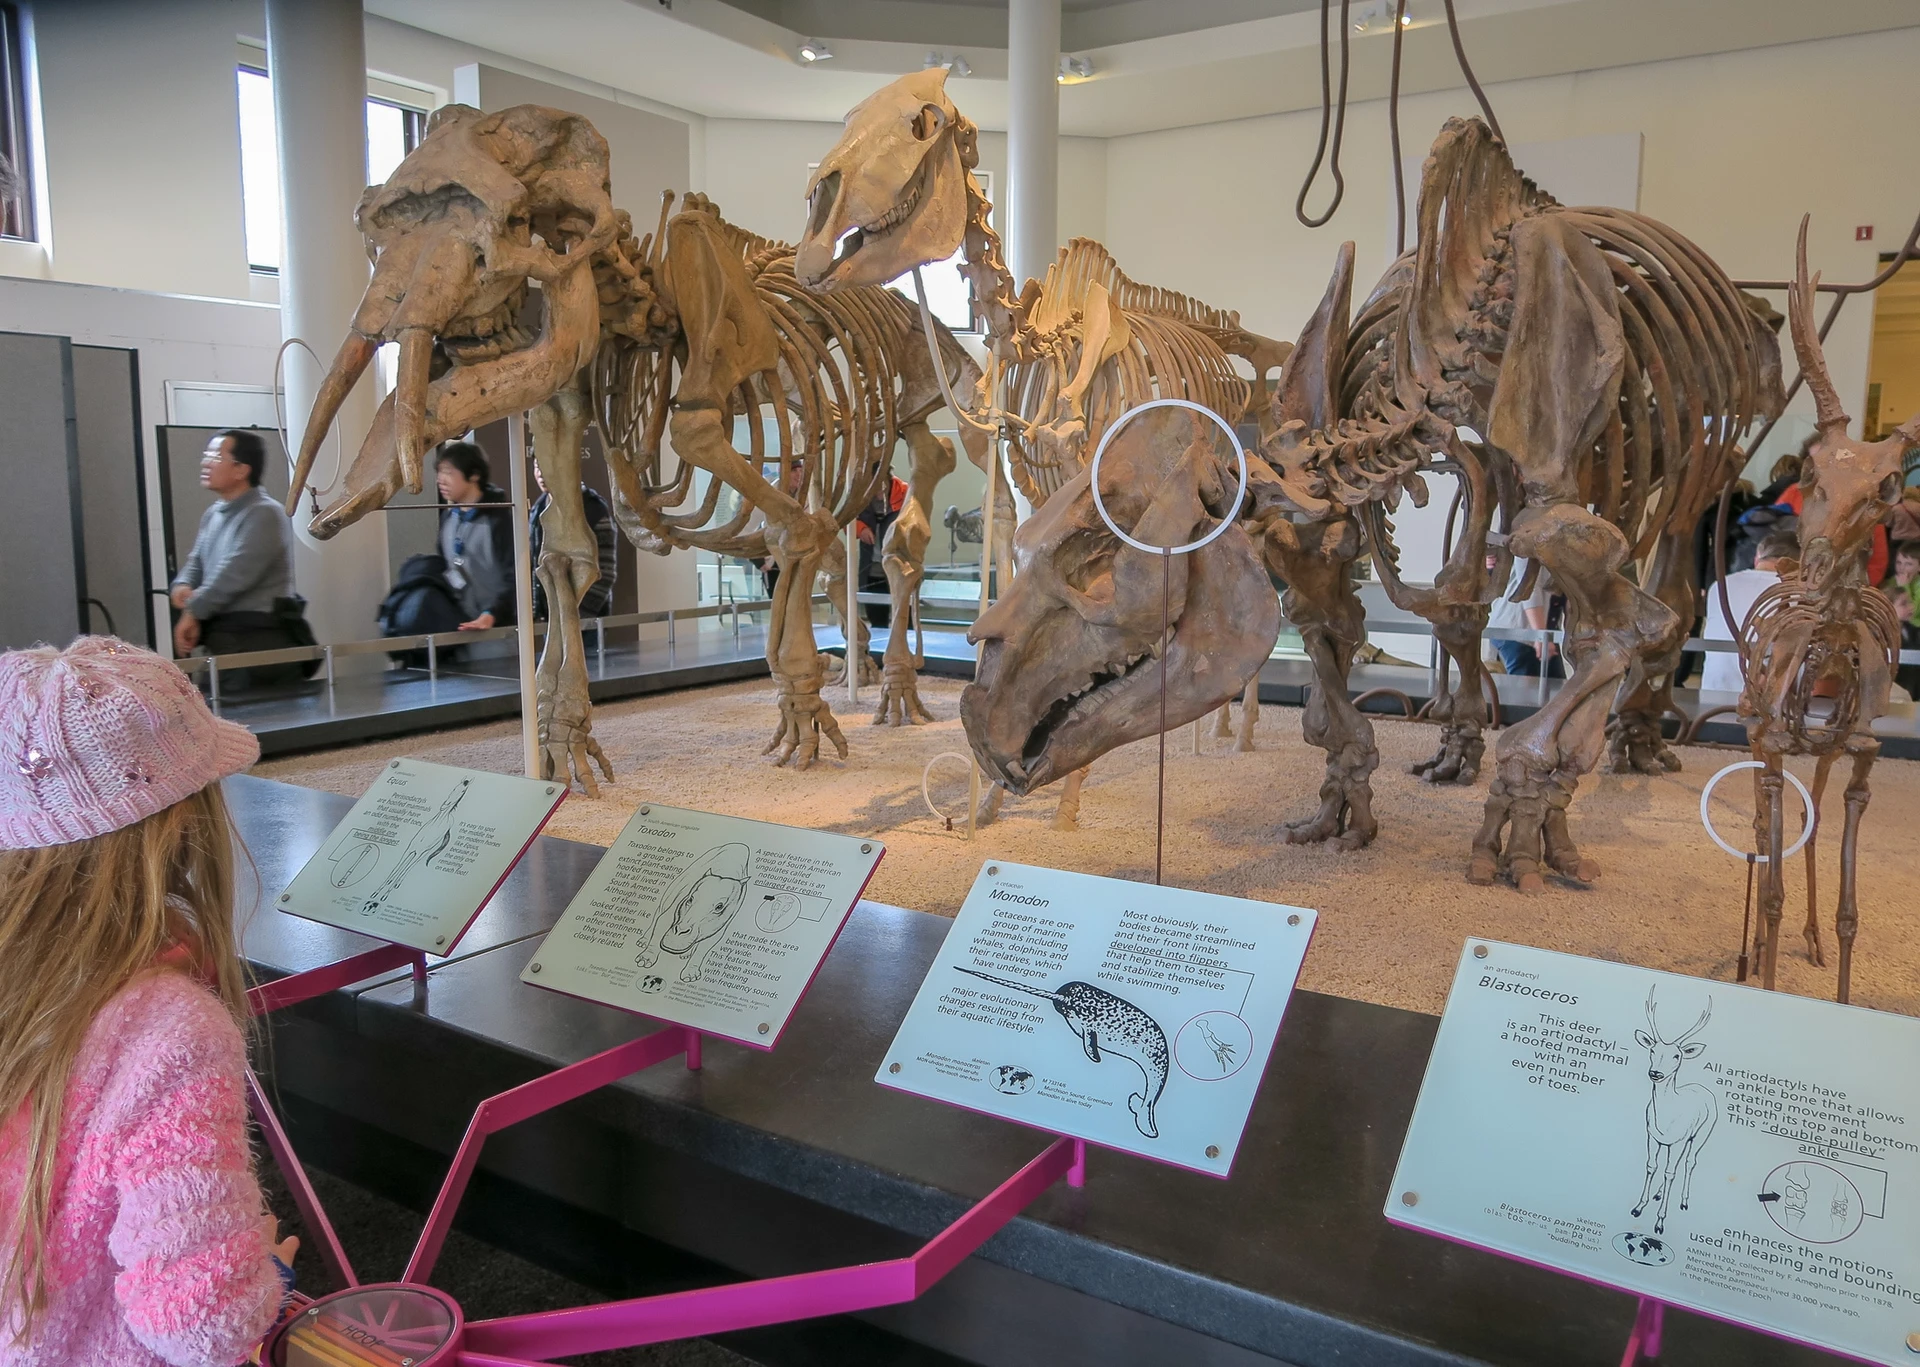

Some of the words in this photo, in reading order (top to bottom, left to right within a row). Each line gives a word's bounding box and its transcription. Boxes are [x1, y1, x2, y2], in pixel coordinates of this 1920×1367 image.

[387, 776, 407, 785] Equus
[639, 825, 676, 838] Toxodon
[629, 840, 657, 850] Toxodon
[656, 846, 685, 857] belongs
[641, 853, 664, 861] group
[786, 854, 811, 863] feature
[615, 863, 642, 872] hoofed
[618, 856, 641, 864] extinct
[640, 860, 683, 874] plant-eating
[754, 857, 776, 865] group
[785, 861, 807, 869] South
[807, 865, 841, 876] American
[755, 864, 789, 874] ungulates
[609, 878, 630, 887] South
[988, 888, 1050, 907] Monodon
[592, 910, 636, 923] plant-eaters
[992, 909, 1037, 923] Cetaceans
[1038, 918, 1055, 926] are
[1055, 921, 1075, 929] one
[1122, 910, 1149, 920] Most
[1150, 915, 1199, 930] obviously,
[1203, 923, 1228, 934] their
[572, 932, 596, 942] closely
[980, 928, 1024, 941] mammals
[1024, 935, 1068, 951] including
[990, 920, 1019, 931] group
[1020, 924, 1032, 932] of
[1033, 928, 1066, 938] marine
[1118, 919, 1151, 931] bodies
[1152, 925, 1191, 938] became
[1193, 934, 1256, 949] streamlined
[972, 937, 1004, 949] whales,
[1007, 943, 1048, 956] dolphins
[1049, 952, 1069, 960] and
[1110, 940, 1163, 955] developed
[1164, 949, 1186, 959] into
[1188, 953, 1229, 967] flippers
[1113, 931, 1134, 939] and
[1135, 934, 1160, 944] their
[1162, 937, 1189, 949] front
[1191, 942, 1219, 954] limbs
[967, 946, 990, 956] their
[991, 951, 1030, 965] relatives,
[1034, 959, 1063, 970] which
[972, 957, 994, 968] have
[995, 963, 1047, 978] undergone
[1105, 950, 1127, 960] that
[1128, 954, 1151, 966] help
[1154, 959, 1181, 970] them
[1184, 964, 1195, 973] to
[1197, 968, 1225, 978] steer
[1096, 971, 1124, 981] while
[1126, 977, 1180, 994] swimming.
[1101, 961, 1121, 969] and
[1122, 965, 1165, 978] stabilize
[1167, 972, 1225, 989] themselves
[1495, 967, 1539, 979] artiodactyl
[951, 987, 978, 997] major
[979, 993, 1038, 1012] evolutionary
[1478, 975, 1578, 1005] Blastoceros
[936, 1005, 959, 1015] their
[960, 1011, 994, 1024] aquatic
[996, 1017, 1034, 1033] lifestyle.
[938, 994, 976, 1008] changes
[977, 1004, 1018, 1020] resulting
[1020, 1011, 1044, 1023] from
[1506, 1018, 1516, 1029] is
[1519, 1023, 1536, 1033] an
[1541, 1028, 1616, 1050] artiodactyl
[1539, 1012, 1565, 1027] This
[1568, 1020, 1601, 1034] deer
[1512, 1032, 1562, 1051] hoofed
[1566, 1046, 1629, 1065] mammal
[1533, 1051, 1565, 1064] with
[1569, 1059, 1587, 1069] an
[925, 1052, 951, 1062] Monodon
[951, 1059, 980, 1069] monoceros
[1511, 1059, 1544, 1072] even
[1548, 1067, 1605, 1085] number
[1527, 1074, 1544, 1085] of
[1547, 1078, 1579, 1093] toes.
[1703, 1061, 1722, 1073] All
[1726, 1068, 1807, 1091] artiodactyls
[1812, 1083, 1846, 1099] have
[1715, 1078, 1732, 1087] an
[1737, 1082, 1776, 1096] ankle
[1780, 1089, 1816, 1105] bone
[1821, 1098, 1852, 1112] that
[1857, 1107, 1905, 1124] allows
[1725, 1091, 1782, 1112] rotating
[1787, 1105, 1867, 1128] movement
[1726, 1103, 1741, 1112] at
[1745, 1105, 1777, 1120] both
[1782, 1113, 1798, 1125] its
[1802, 1118, 1826, 1132] top
[1830, 1126, 1858, 1138] and
[1728, 1112, 1756, 1127] This
[1798, 1143, 1839, 1159] ankle
[1500, 1202, 1551, 1222] Blastoceros
[1553, 1219, 1601, 1236] pampaeus
[1576, 1217, 1605, 1228] skeleton
[1689, 1233, 1723, 1248] used
[1728, 1240, 1741, 1253] in
[1746, 1245, 1803, 1272] leaping
[1808, 1264, 1838, 1279] and
[1723, 1228, 1793, 1253] enhances
[1797, 1246, 1823, 1261] the
[1829, 1256, 1893, 1279] motions
[1686, 1256, 1723, 1271] Mercedes,
[1726, 1267, 1765, 1281] Argentina
[1739, 1263, 1773, 1275] collected
[1775, 1271, 1784, 1279] by
[1795, 1277, 1836, 1292] Ameghino
[1839, 1290, 1858, 1298] prior
[341, 1324, 386, 1348] HOOF
